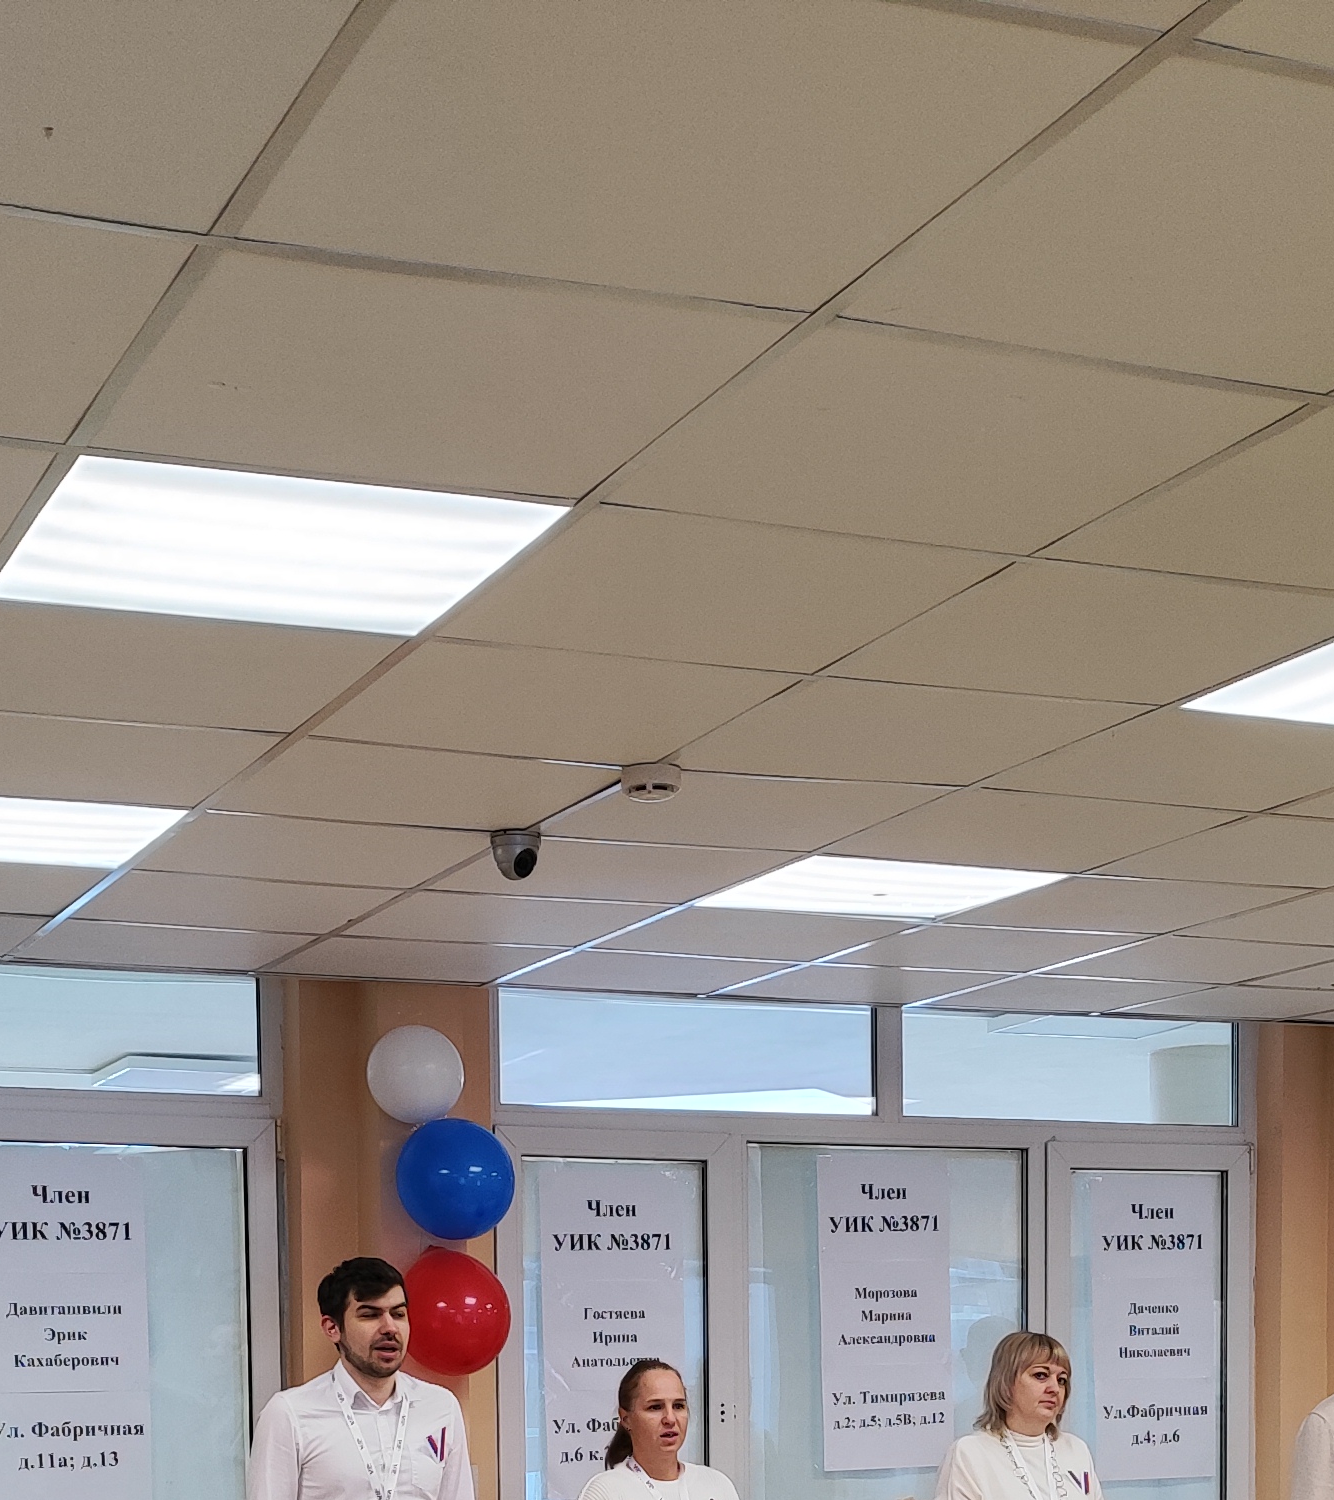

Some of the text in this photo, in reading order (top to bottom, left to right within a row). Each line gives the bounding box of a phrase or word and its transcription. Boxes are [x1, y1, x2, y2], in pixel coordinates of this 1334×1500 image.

[30, 1184, 90, 1204] Член
[860, 1183, 907, 1201] Член
[586, 1200, 637, 1217] Член
[1130, 1203, 1174, 1220] Член
[55, 1220, 133, 1241] №3871
[828, 1214, 940, 1234] УИК №3871
[552, 1232, 672, 1252] УИК №3871
[1101, 1234, 1203, 1252] УИК №3871
[854, 1287, 918, 1301] Морозова
[5, 1302, 122, 1318] Давиташвили
[583, 1307, 646, 1321] Гостяева
[861, 1310, 912, 1324] Марина
[1127, 1302, 1179, 1316] Дяченко
[43, 1328, 88, 1345] Эрик
[592, 1331, 638, 1346] Ирина
[1128, 1324, 1180, 1336] Виталий
[838, 1333, 936, 1347] Александровна
[1118, 1346, 1191, 1359] Николаевич
[13, 1353, 120, 1370] Кахаберович
[831, 1390, 946, 1406] Ул. Тимирязева
[919, 1411, 945, 1427] д.12
[1103, 1404, 1208, 1421] Ул.Фабричная
[31, 1421, 145, 1441] Фабричная
[552, 1418, 581, 1434] Ул.
[1160, 1429, 1180, 1445] д.6
[17, 1451, 119, 1471] д.11а; д.13
[560, 1446, 584, 1464] д.6
